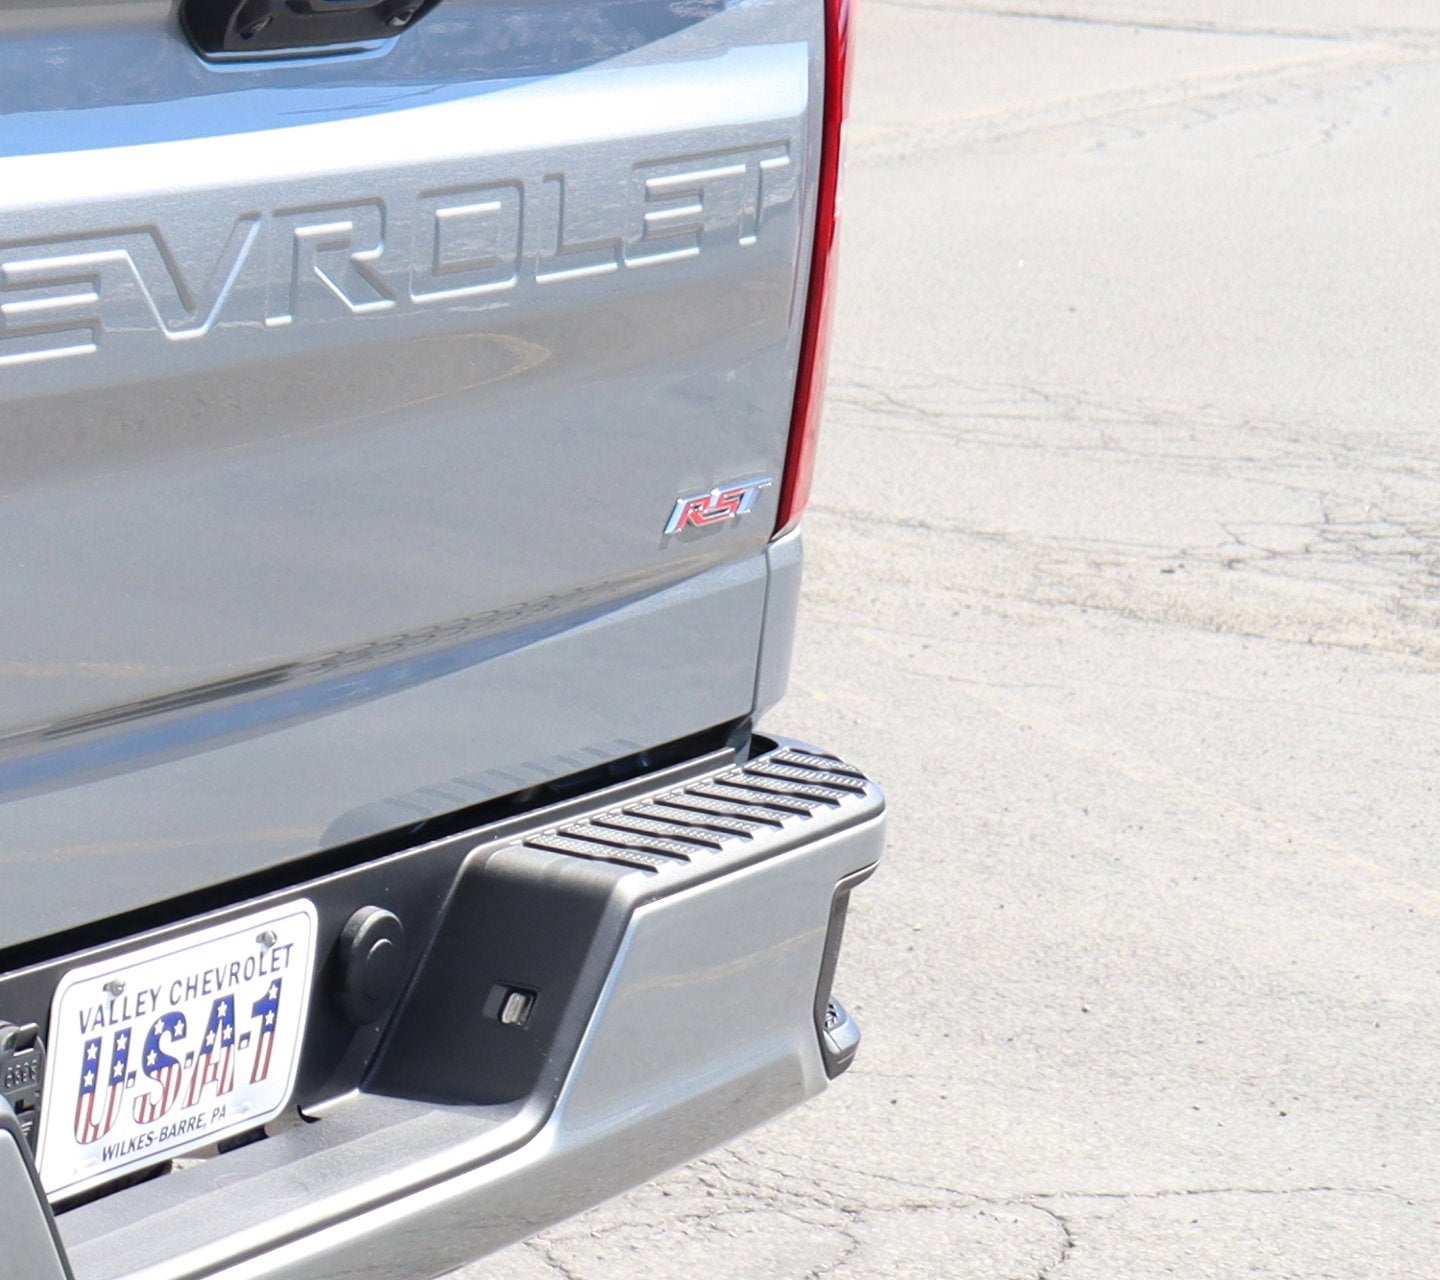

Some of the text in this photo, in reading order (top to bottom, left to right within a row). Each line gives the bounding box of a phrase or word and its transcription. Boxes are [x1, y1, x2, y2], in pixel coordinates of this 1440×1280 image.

[664, 476, 774, 534] RST
[79, 943, 293, 1035] VALLEY CHEVROLET
[210, 1104, 227, 1124] PA
